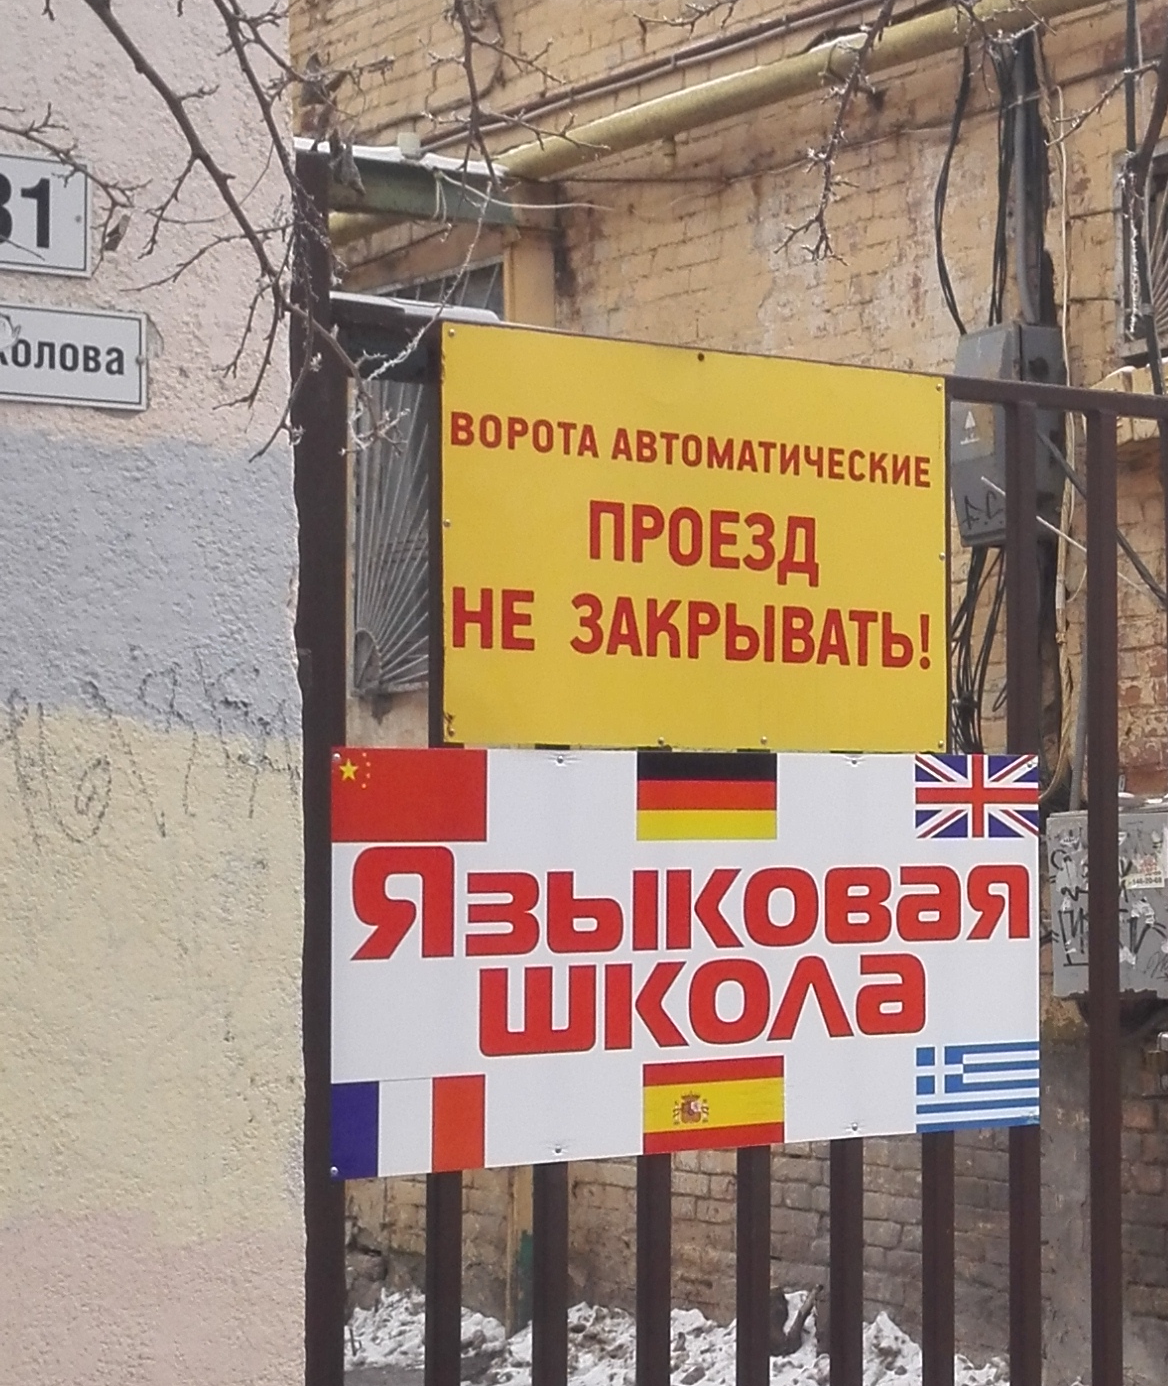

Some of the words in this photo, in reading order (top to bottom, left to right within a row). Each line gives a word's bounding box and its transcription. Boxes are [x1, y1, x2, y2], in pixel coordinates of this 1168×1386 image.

[0, 337, 125, 376] олова
[450, 411, 599, 459] ВОРОТА
[611, 428, 932, 488] АВТОМАТИЧЕСКИЕ
[589, 499, 820, 588] ПРОЕЗД
[452, 586, 535, 652] НЕ
[570, 592, 932, 671] ЗАКРЫВАТЬ!
[351, 845, 1031, 961] Языковая
[478, 952, 928, 1058] школа
